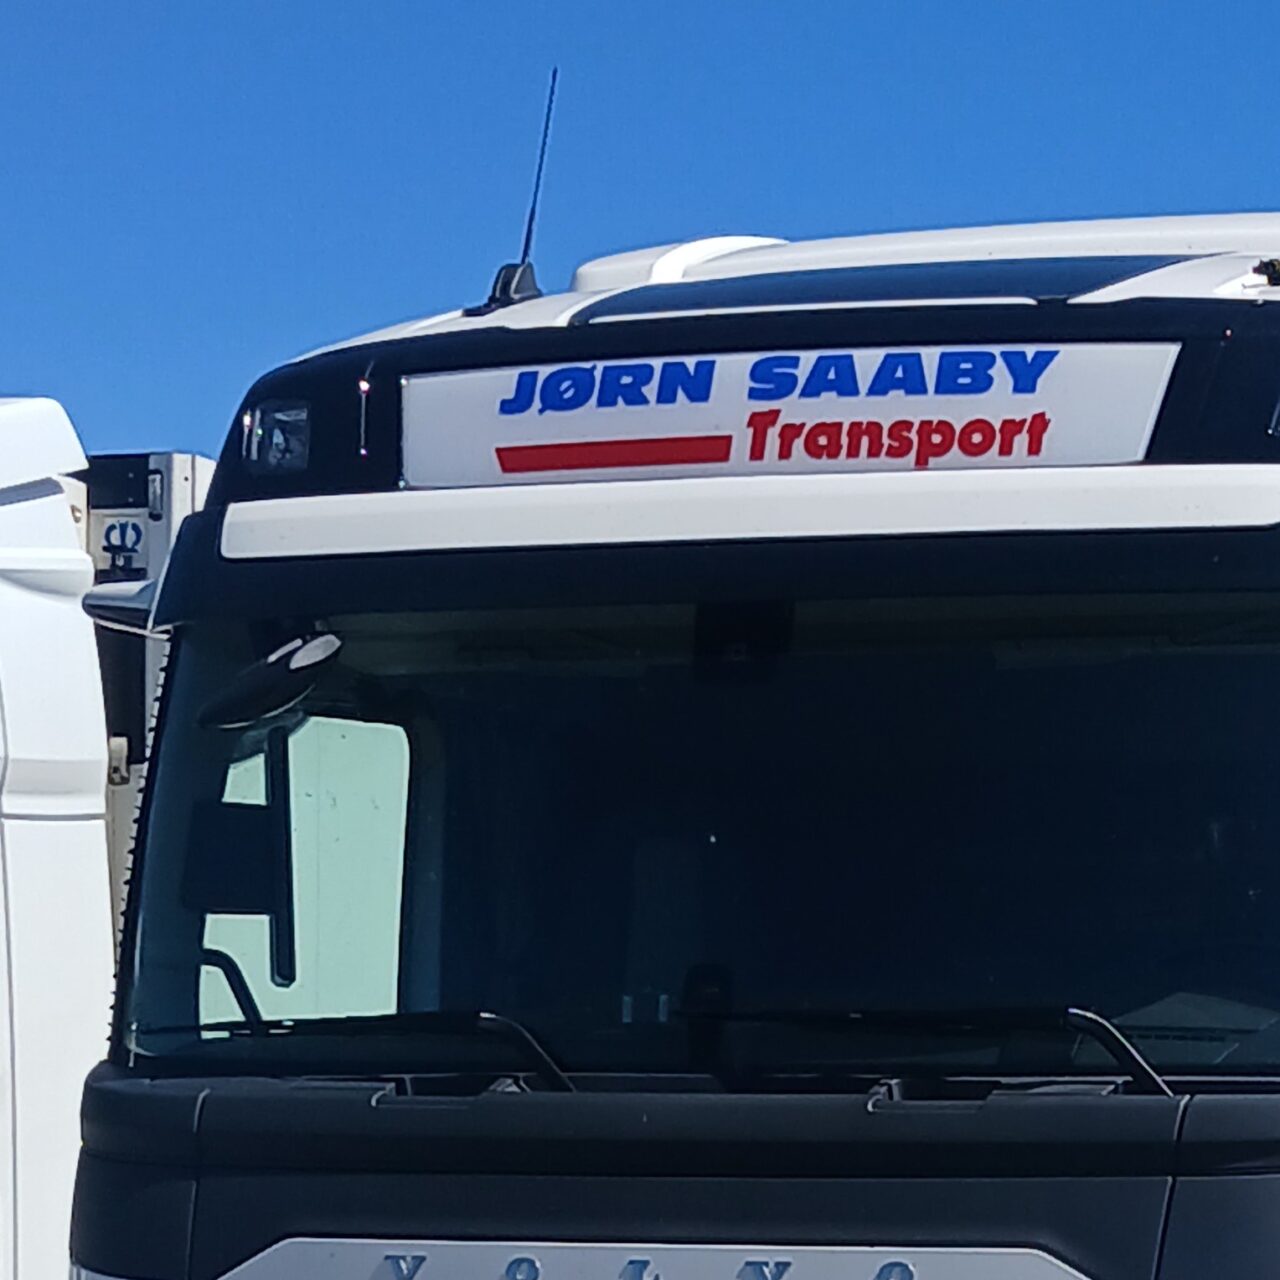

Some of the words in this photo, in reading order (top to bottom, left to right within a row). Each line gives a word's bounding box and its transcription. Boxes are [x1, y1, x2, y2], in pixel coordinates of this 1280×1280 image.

[497, 360, 716, 416] JØRN
[746, 350, 1060, 400] SAABY
[745, 409, 1051, 470] Transport
